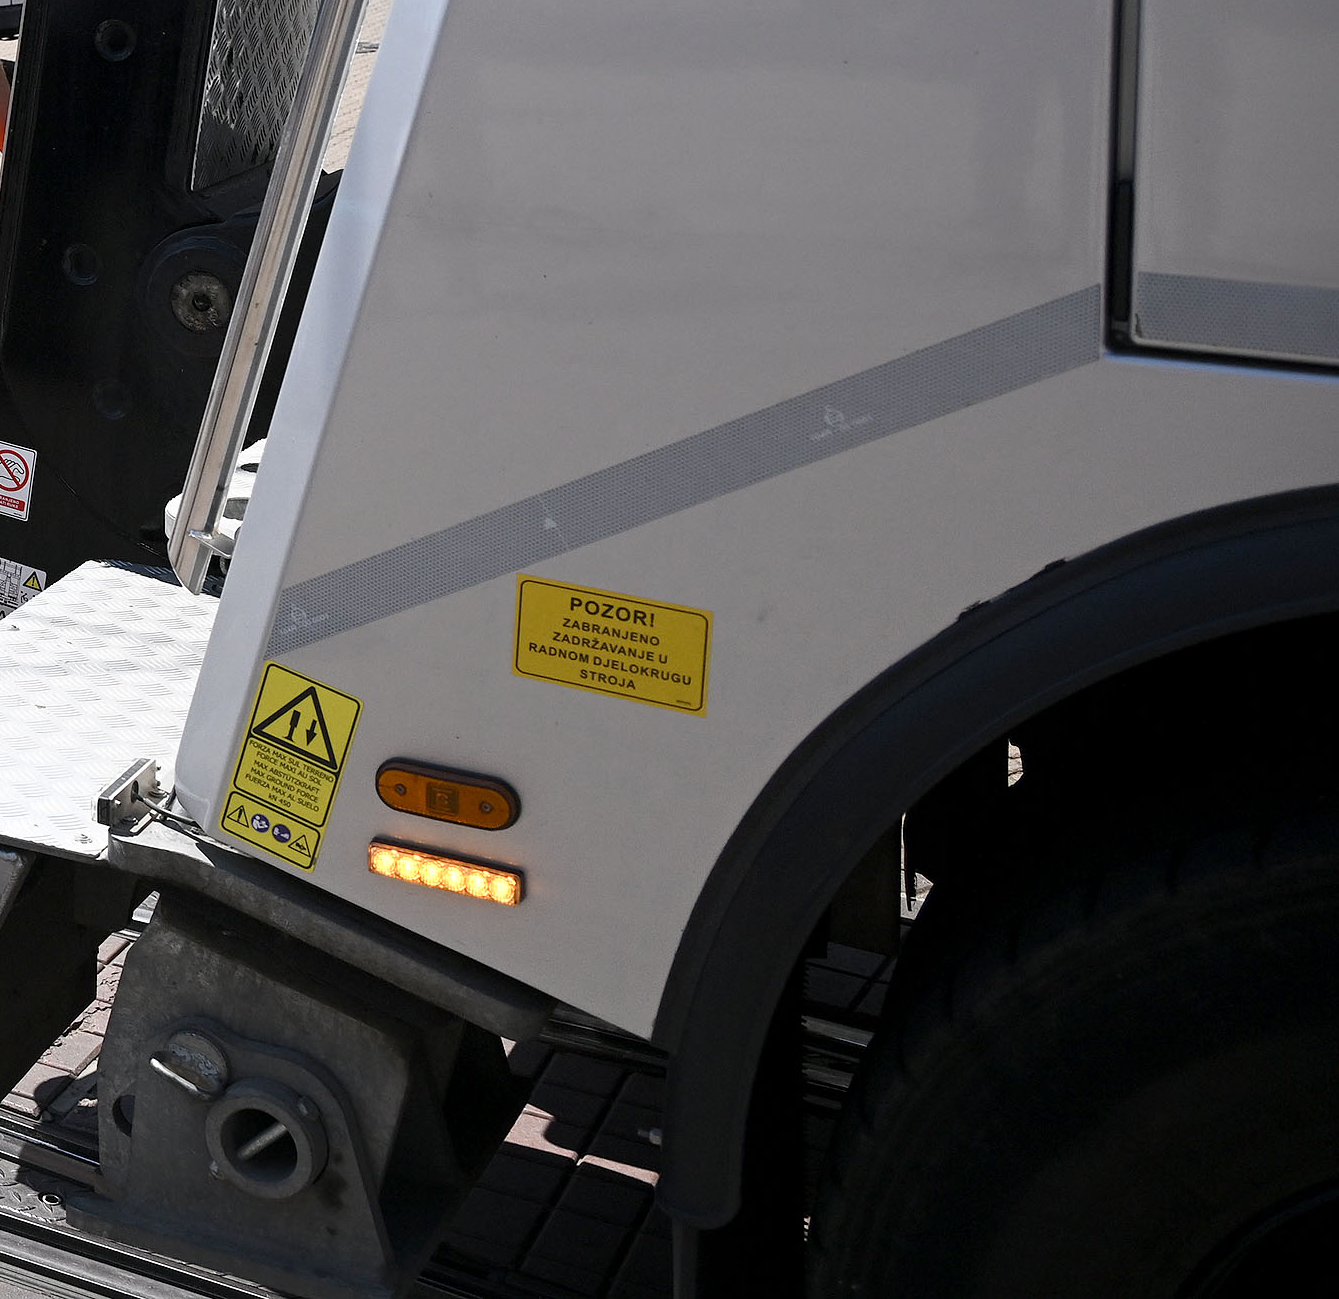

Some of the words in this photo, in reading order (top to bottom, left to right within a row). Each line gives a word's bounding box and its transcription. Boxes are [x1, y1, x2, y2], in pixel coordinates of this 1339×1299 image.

[570, 596, 655, 628] POZOR!
[552, 631, 655, 662] ZADRŽAVANJE
[659, 654, 668, 664] U
[562, 618, 660, 646] ZABRANJENO
[528, 642, 589, 664] RADNOM
[593, 656, 692, 686] DJELOKRUGU
[579, 669, 636, 690] STROJA
[249, 740, 271, 754] FORZA
[273, 750, 286, 761] MAX
[288, 757, 300, 768] SUL
[303, 764, 334, 783] TERRENO
[254, 760, 268, 770] MAX
[256, 751, 277, 766] FORCE
[280, 762, 297, 774] MAXI
[298, 770, 308, 779] AU
[309, 775, 322, 787] SOL
[245, 773, 270, 789] FUERZA
[272, 786, 286, 797] MAX
[287, 793, 296, 801] AL
[297, 797, 319, 812] SUELO
[251, 767, 264, 777] MAX
[266, 774, 295, 792] GROUND
[297, 788, 319, 803] FORCE
[279, 798, 291, 808] 450
